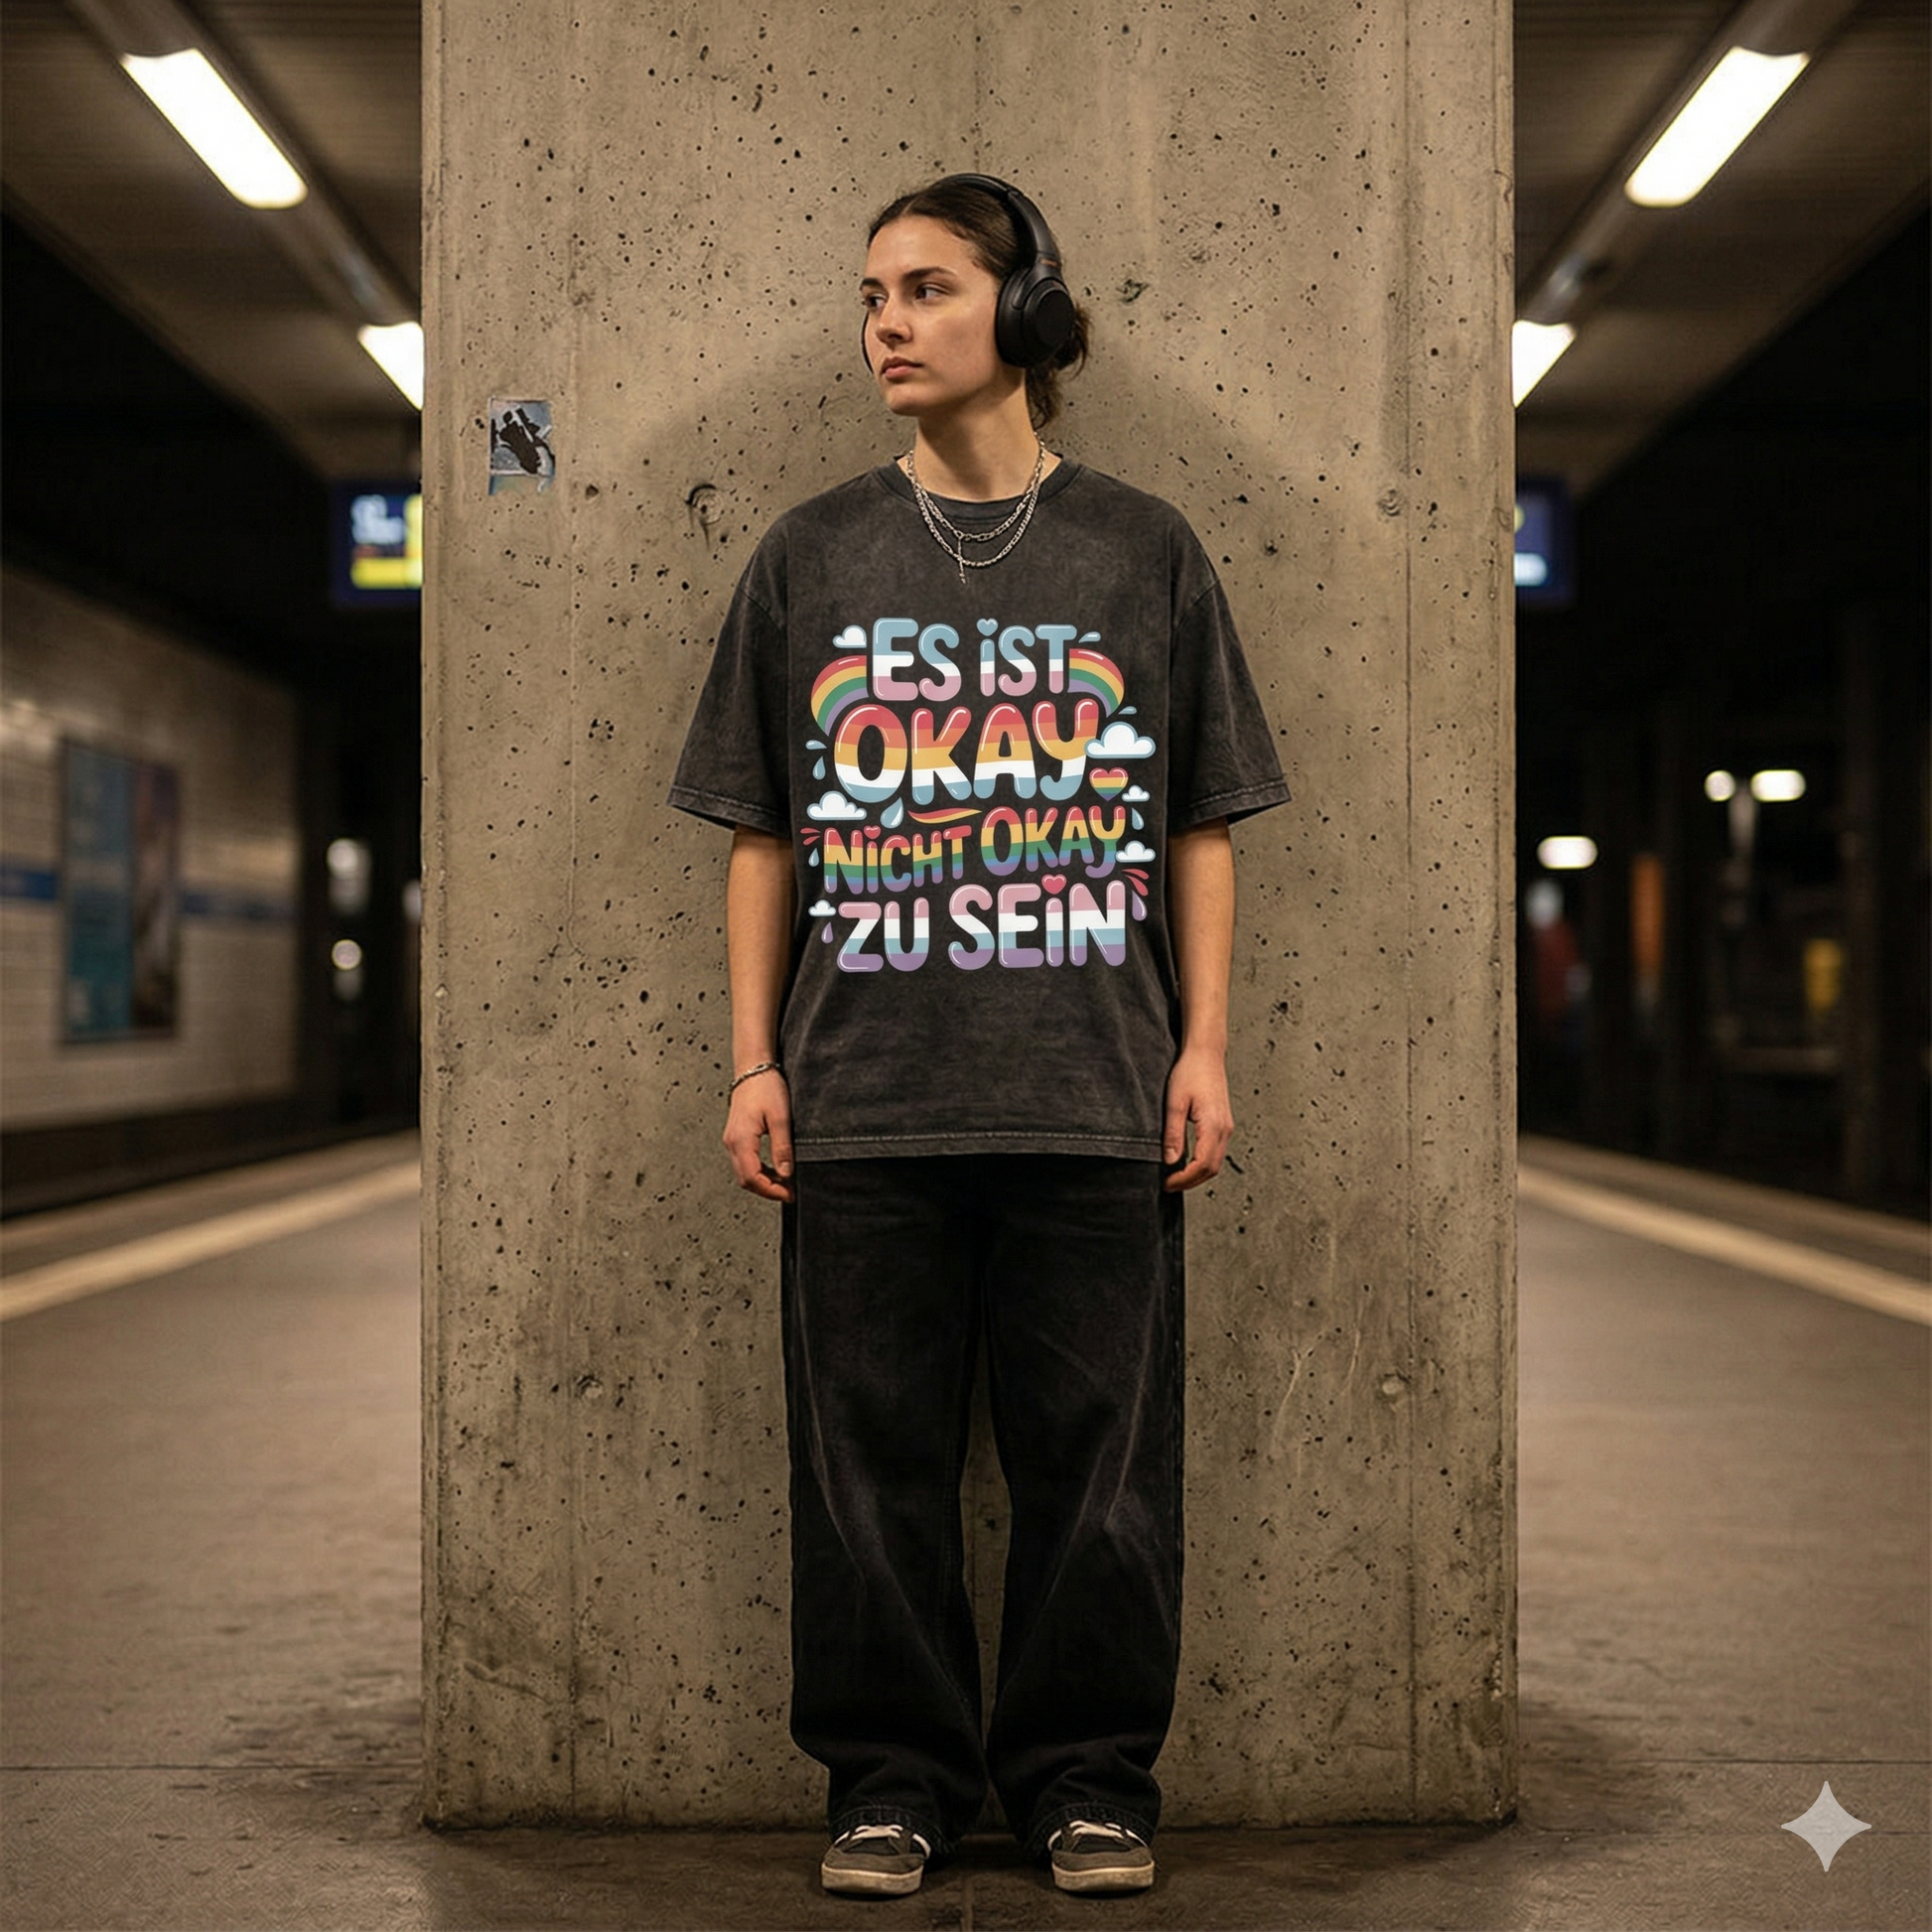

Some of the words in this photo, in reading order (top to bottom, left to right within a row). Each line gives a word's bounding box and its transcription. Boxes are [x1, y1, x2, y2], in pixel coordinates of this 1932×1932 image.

[873, 618, 962, 701] ES
[834, 698, 1099, 805] OKAY
[981, 805, 1126, 878] OKAY
[836, 897, 930, 973] ZU
